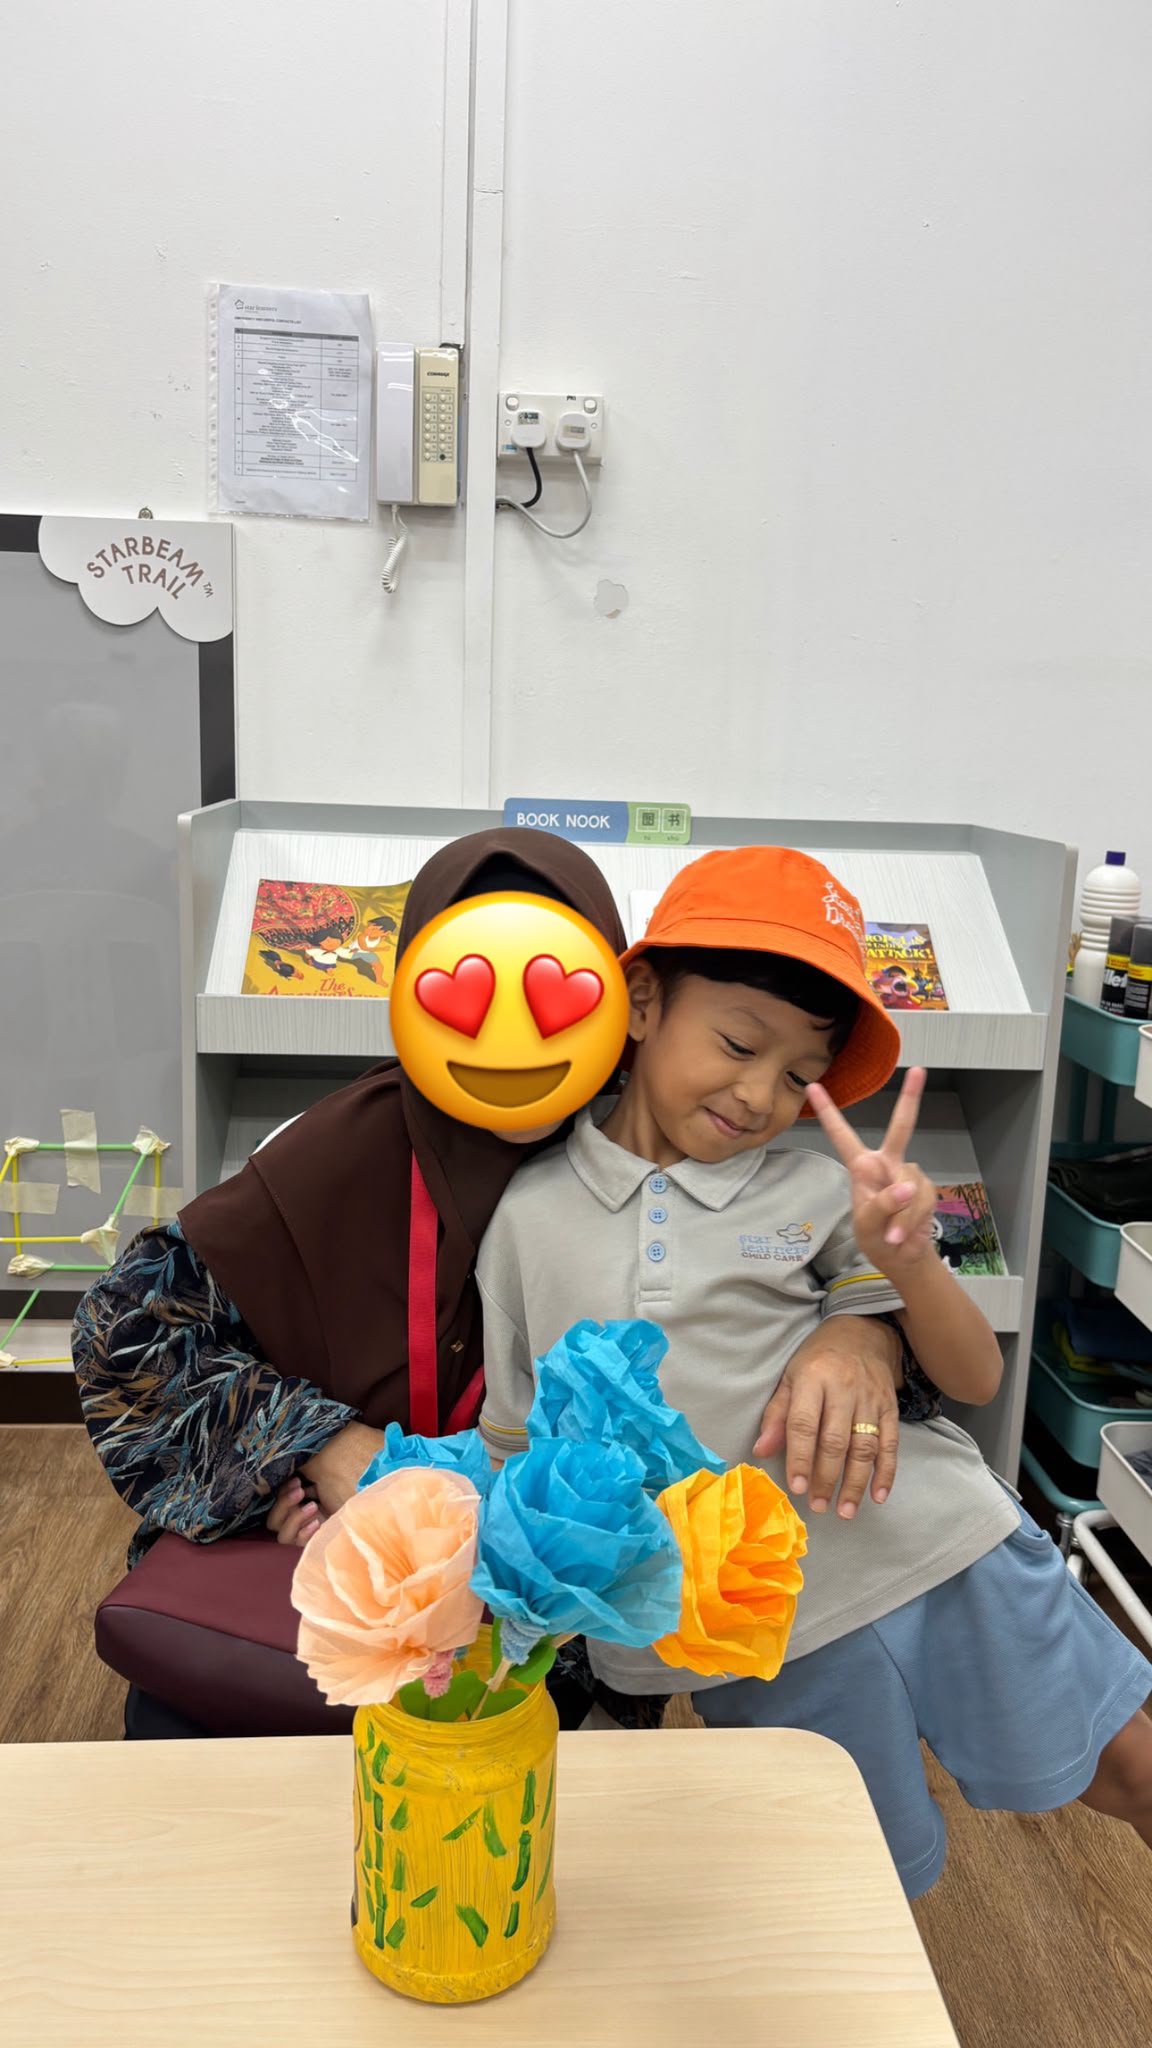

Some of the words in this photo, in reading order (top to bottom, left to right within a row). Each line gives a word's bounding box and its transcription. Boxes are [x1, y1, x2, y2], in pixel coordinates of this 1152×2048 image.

[86, 535, 204, 587] STARBEAM
[121, 563, 188, 600] TRAIL
[516, 812, 560, 827] BOOK
[565, 814, 611, 829] NOOK
[319, 978, 345, 992] The
[741, 1251, 771, 1260] CHILD
[773, 1254, 804, 1262] CARE
